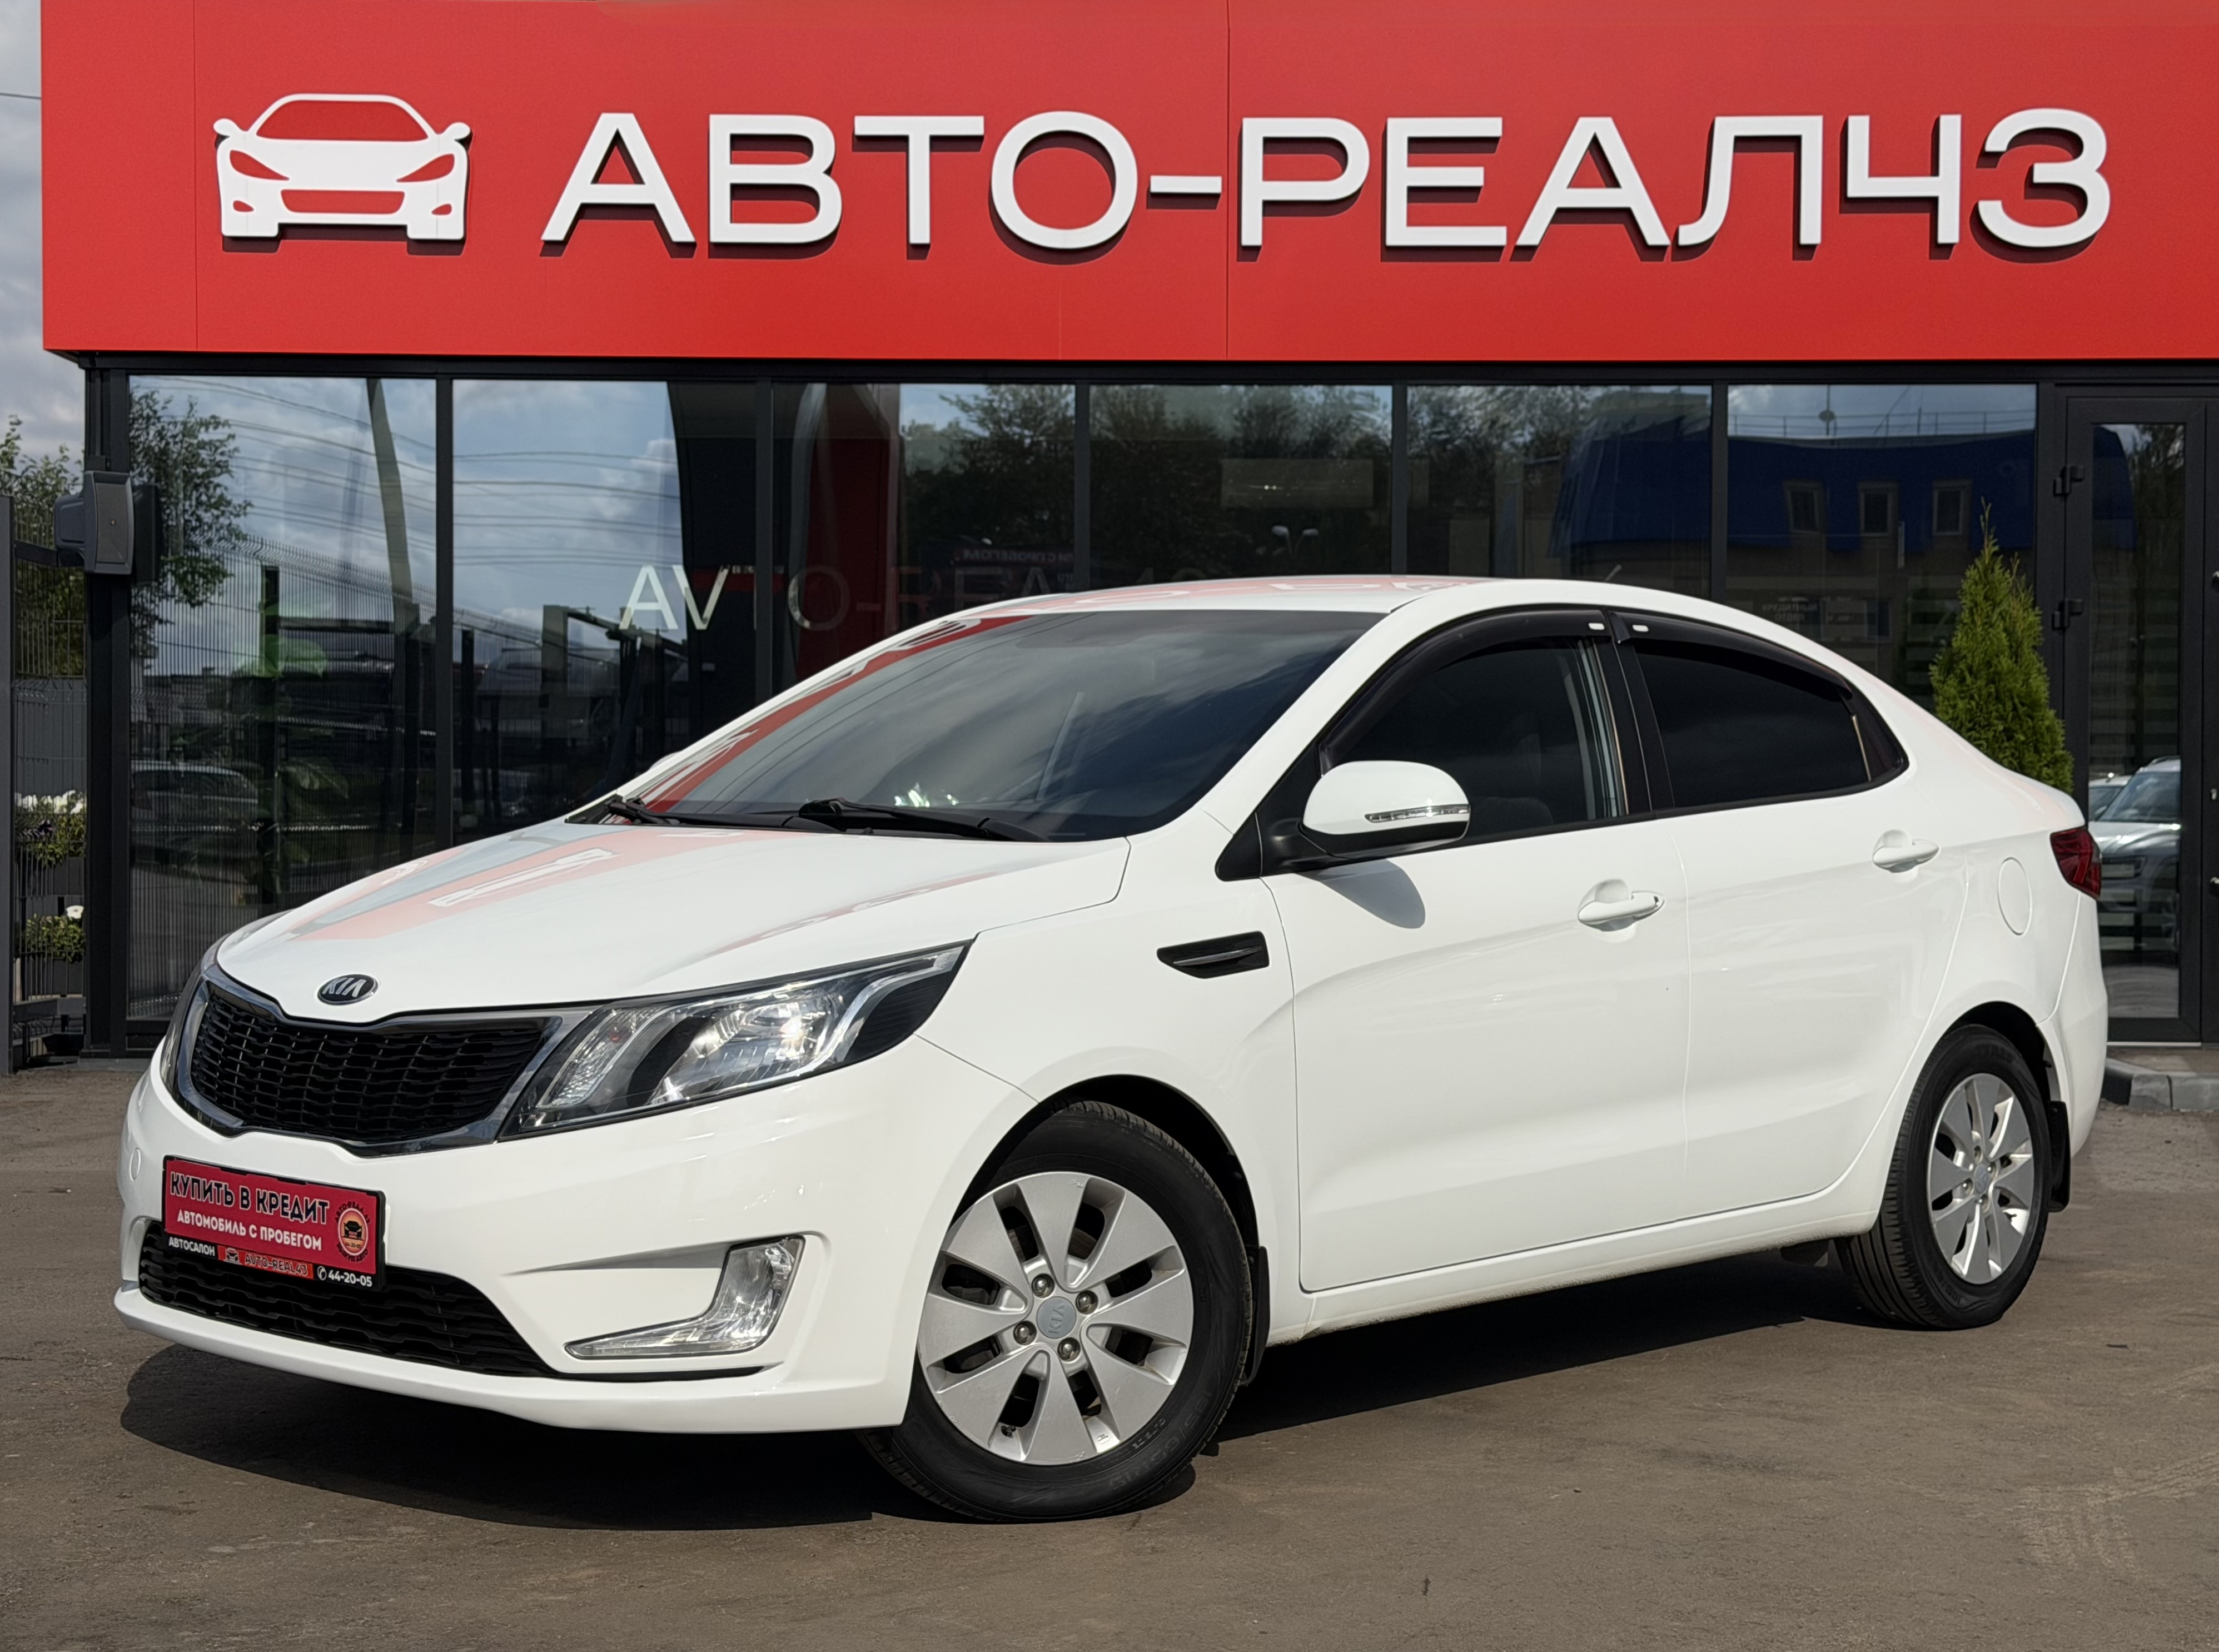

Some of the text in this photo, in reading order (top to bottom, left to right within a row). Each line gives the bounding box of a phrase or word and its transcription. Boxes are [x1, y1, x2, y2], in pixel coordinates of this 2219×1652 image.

[322, 977, 366, 997] KIA
[171, 1171, 330, 1225] КУПИТЬ В КРЕДИТ
[177, 1209, 322, 1251] АВТОМОБИЛЬ С ПРОБЕГОМ
[168, 1237, 216, 1256] АВТОСАЛОН
[245, 1253, 308, 1276] AVTO-REAL43
[329, 1270, 372, 1287] 44-20-05
[1048, 1302, 1068, 1335] KIA
